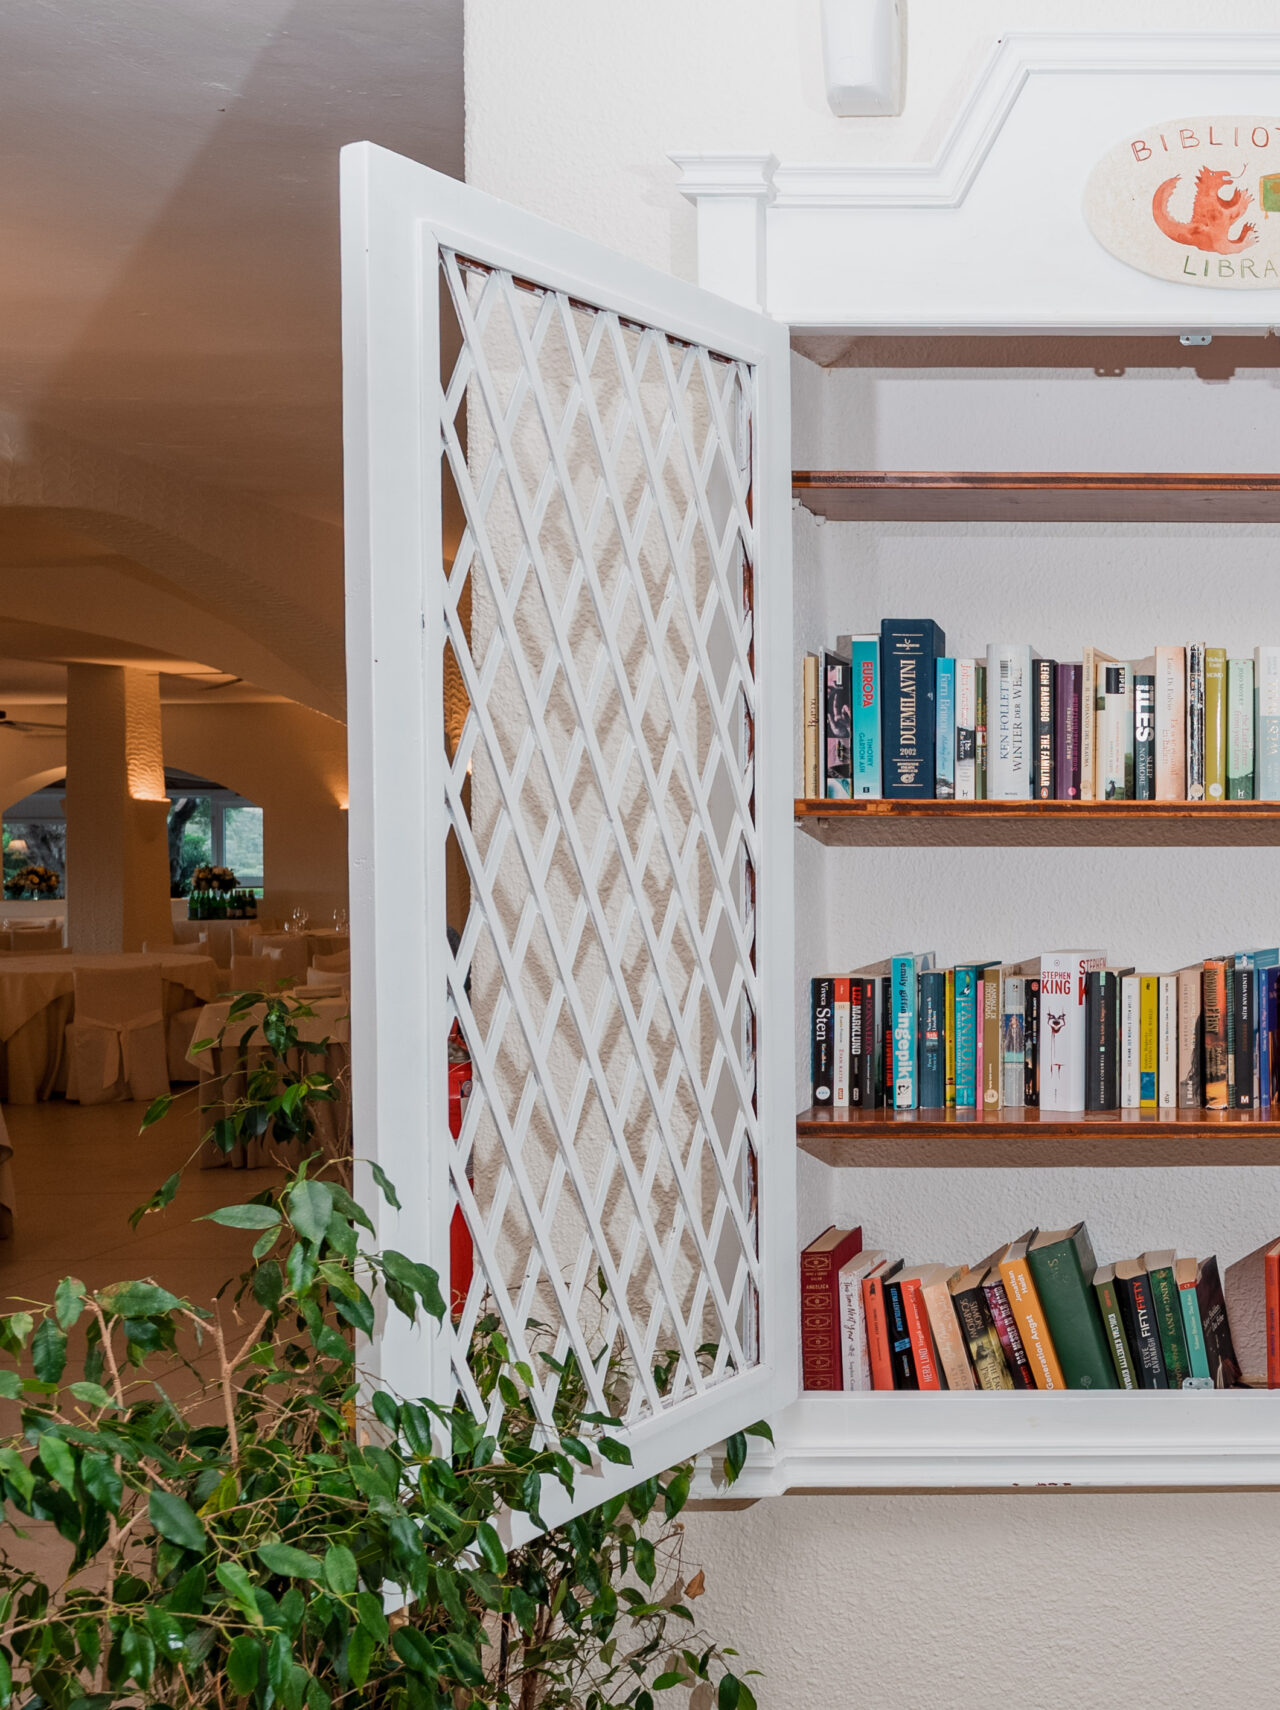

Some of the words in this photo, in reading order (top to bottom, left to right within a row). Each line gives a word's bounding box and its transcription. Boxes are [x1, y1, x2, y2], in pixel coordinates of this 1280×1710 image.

[862, 661, 874, 708] EUROPA
[1040, 662, 1050, 685] LEIGH
[900, 659, 917, 745] DUEMILAVINI
[1040, 686, 1050, 722] BARDUGO
[1135, 690, 1155, 742] ILES
[859, 733, 867, 756] GARTON
[1000, 734, 1010, 760] KEN
[1012, 721, 1023, 772] WINTER
[1040, 734, 1050, 749] THE
[1139, 747, 1147, 759] NO
[859, 758, 867, 773] ASH
[1040, 751, 1050, 786] FAMILIAR
[1139, 762, 1147, 786] MORE
[900, 962, 908, 987] emily
[1042, 971, 1071, 980] STEPHEN
[820, 981, 829, 1006] Viveca
[852, 986, 862, 1006] LIZA
[1041, 979, 1071, 995] KING
[899, 989, 909, 1014] giffin
[816, 1007, 832, 1041] Sten
[852, 1005, 862, 1055] MARKLUND
[865, 1031, 873, 1055] LEON
[961, 1001, 974, 1083] PANDORA
[1007, 1270, 1022, 1302] Jonathan
[1017, 1274, 1029, 1294] Haidt
[1132, 1280, 1147, 1310] FIFTY
[1160, 1281, 1171, 1304] KING
[847, 1308, 857, 1324] Next
[959, 1297, 979, 1340] SCARROW
[970, 1300, 985, 1330] SIMON
[998, 1303, 1010, 1316] DER
[1002, 1317, 1014, 1326] IN
[844, 1324, 856, 1341] Year
[1025, 1314, 1043, 1341] Angst
[1137, 1308, 1152, 1338] FIFTY
[1165, 1312, 1177, 1336] ENVY
[1005, 1325, 1022, 1351] MESSER
[918, 1347, 930, 1364] LIND
[987, 1360, 999, 1375] THE
[1014, 1350, 1027, 1365] DAS
[1035, 1341, 1054, 1390] Generation
[1141, 1346, 1152, 1369] STEVE
[1147, 1337, 1161, 1374] CAVANAGH
[921, 1363, 933, 1383] HERA
[951, 1367, 961, 1390] MILY
